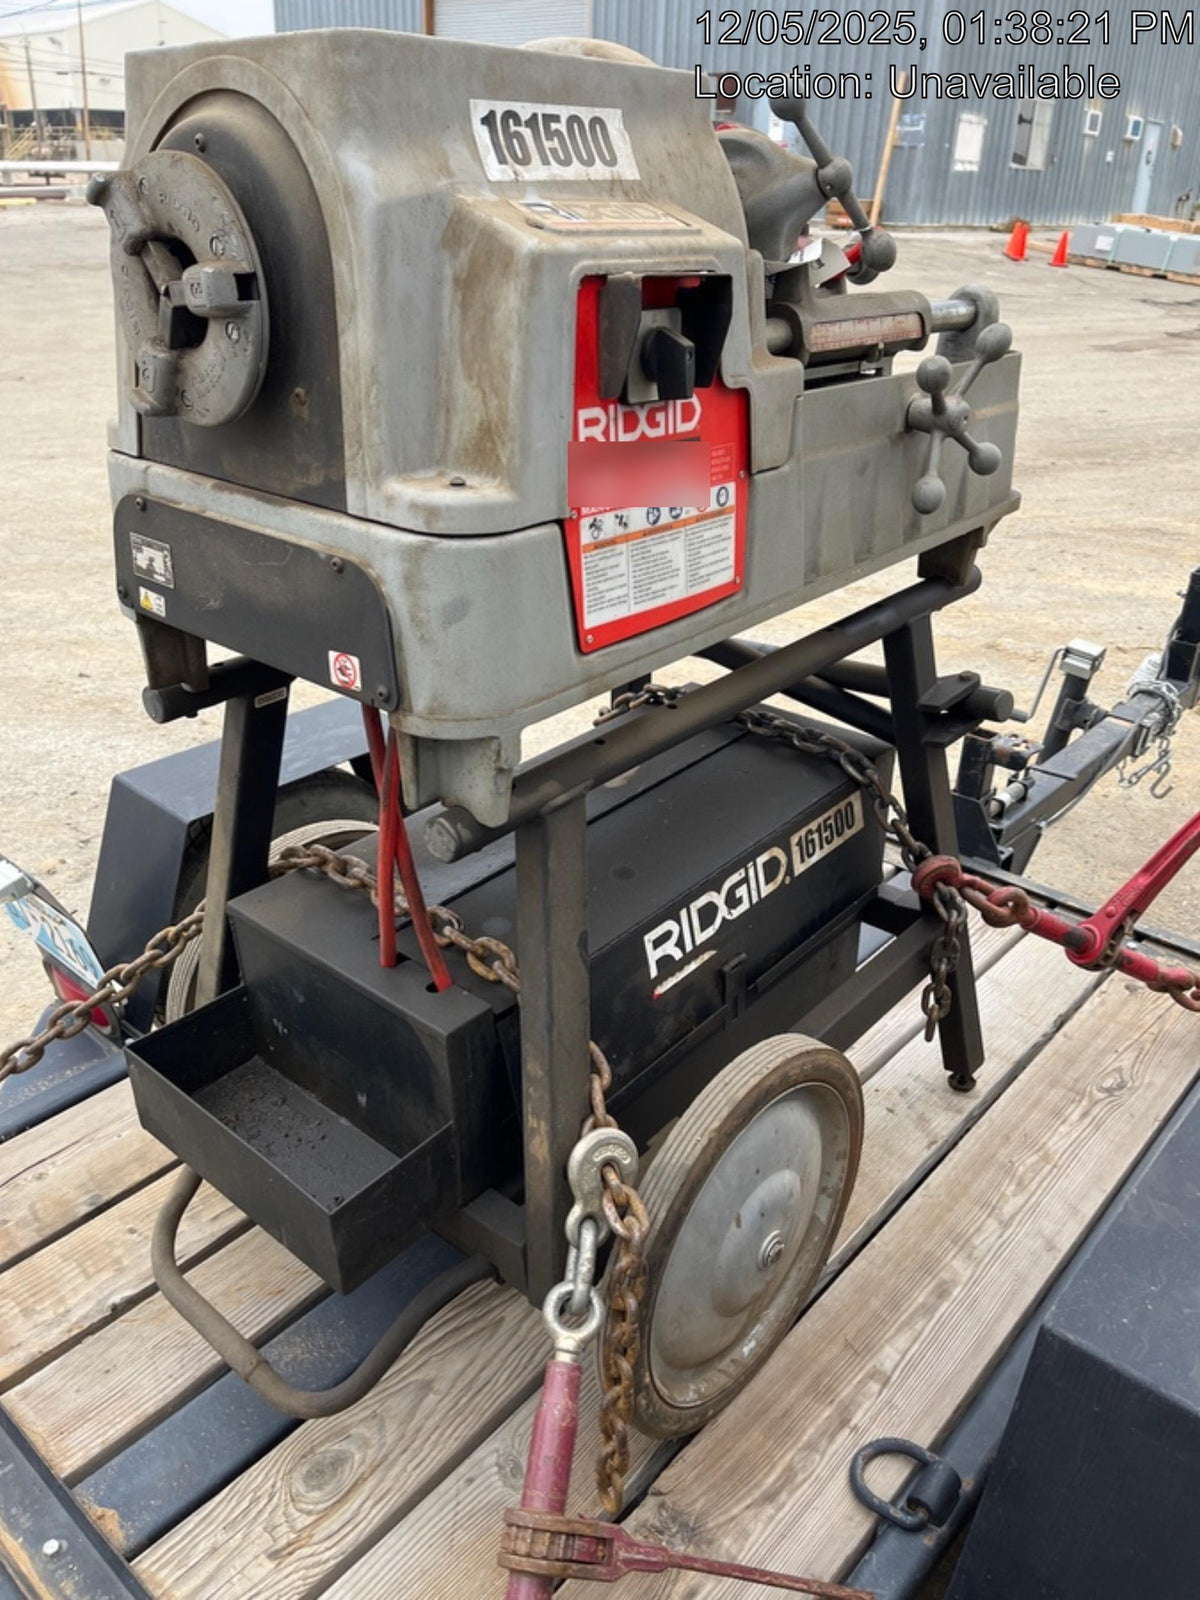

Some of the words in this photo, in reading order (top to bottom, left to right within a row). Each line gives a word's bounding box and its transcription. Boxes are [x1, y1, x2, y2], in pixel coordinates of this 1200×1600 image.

[480, 109, 618, 168] 161500
[577, 395, 702, 442] RIDGID
[795, 801, 856, 865] 161500
